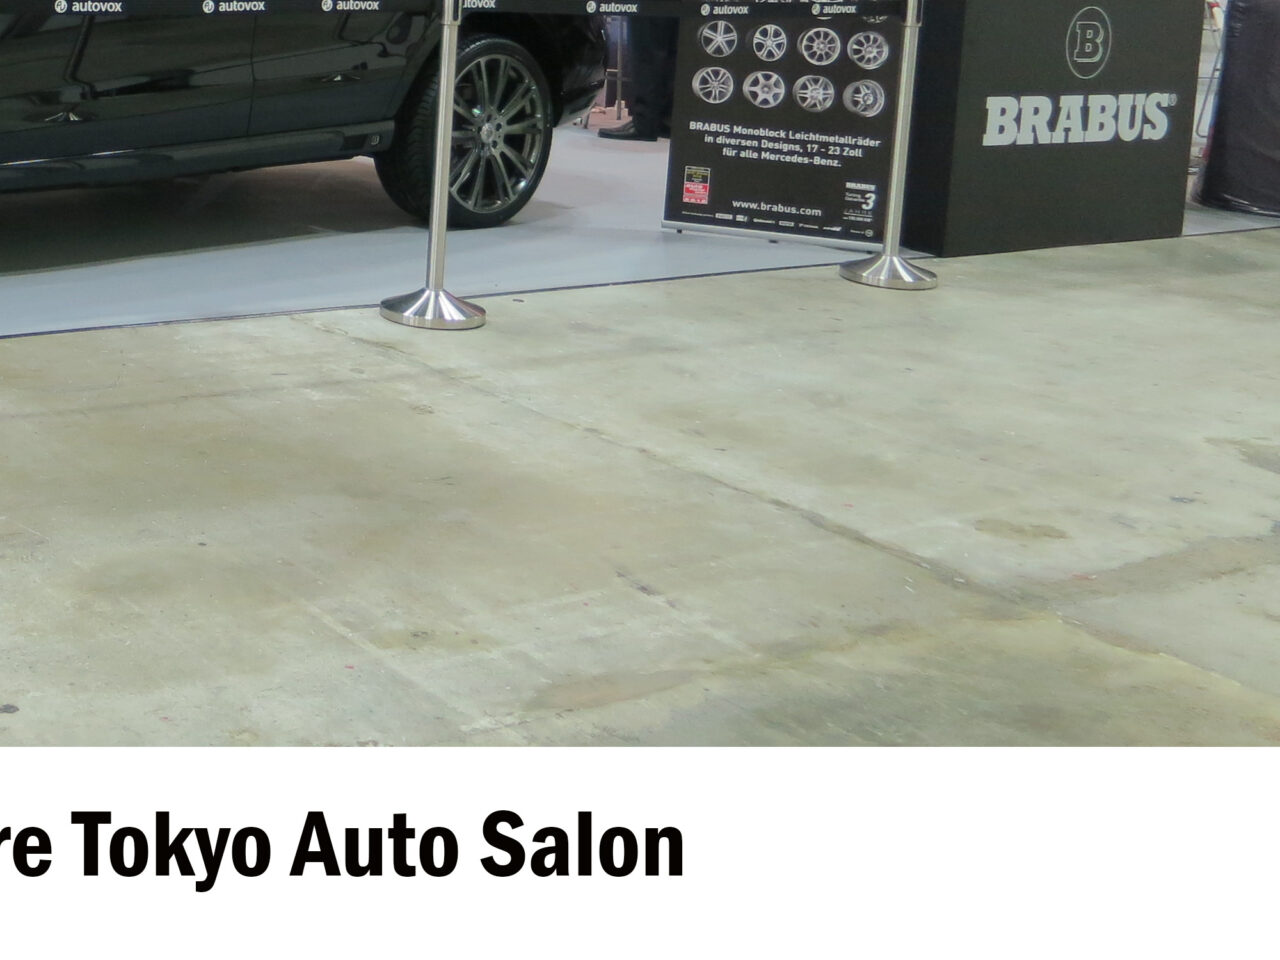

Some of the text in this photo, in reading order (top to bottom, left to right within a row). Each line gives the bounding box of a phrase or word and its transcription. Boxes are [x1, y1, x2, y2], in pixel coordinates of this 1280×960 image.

[72, 0, 123, 13] autovox
[218, 0, 265, 12] autovox
[336, 0, 380, 11] autovox
[599, 2, 638, 14] autovox
[713, 3, 749, 16] autovox
[824, 3, 857, 15] autovox
[982, 92, 1170, 147] BRABUS
[689, 121, 882, 147] BRABUS Monoblock Leichtmetallräder
[704, 134, 714, 143] in
[716, 135, 758, 148] diversen
[761, 140, 803, 153] Designs,
[806, 143, 818, 153] 17
[828, 146, 840, 156] 23
[842, 147, 863, 158] Zoll
[722, 147, 842, 167] für alle Mercedes-Benz.
[732, 199, 822, 216] www.brabus.com
[861, 192, 876, 210] 3
